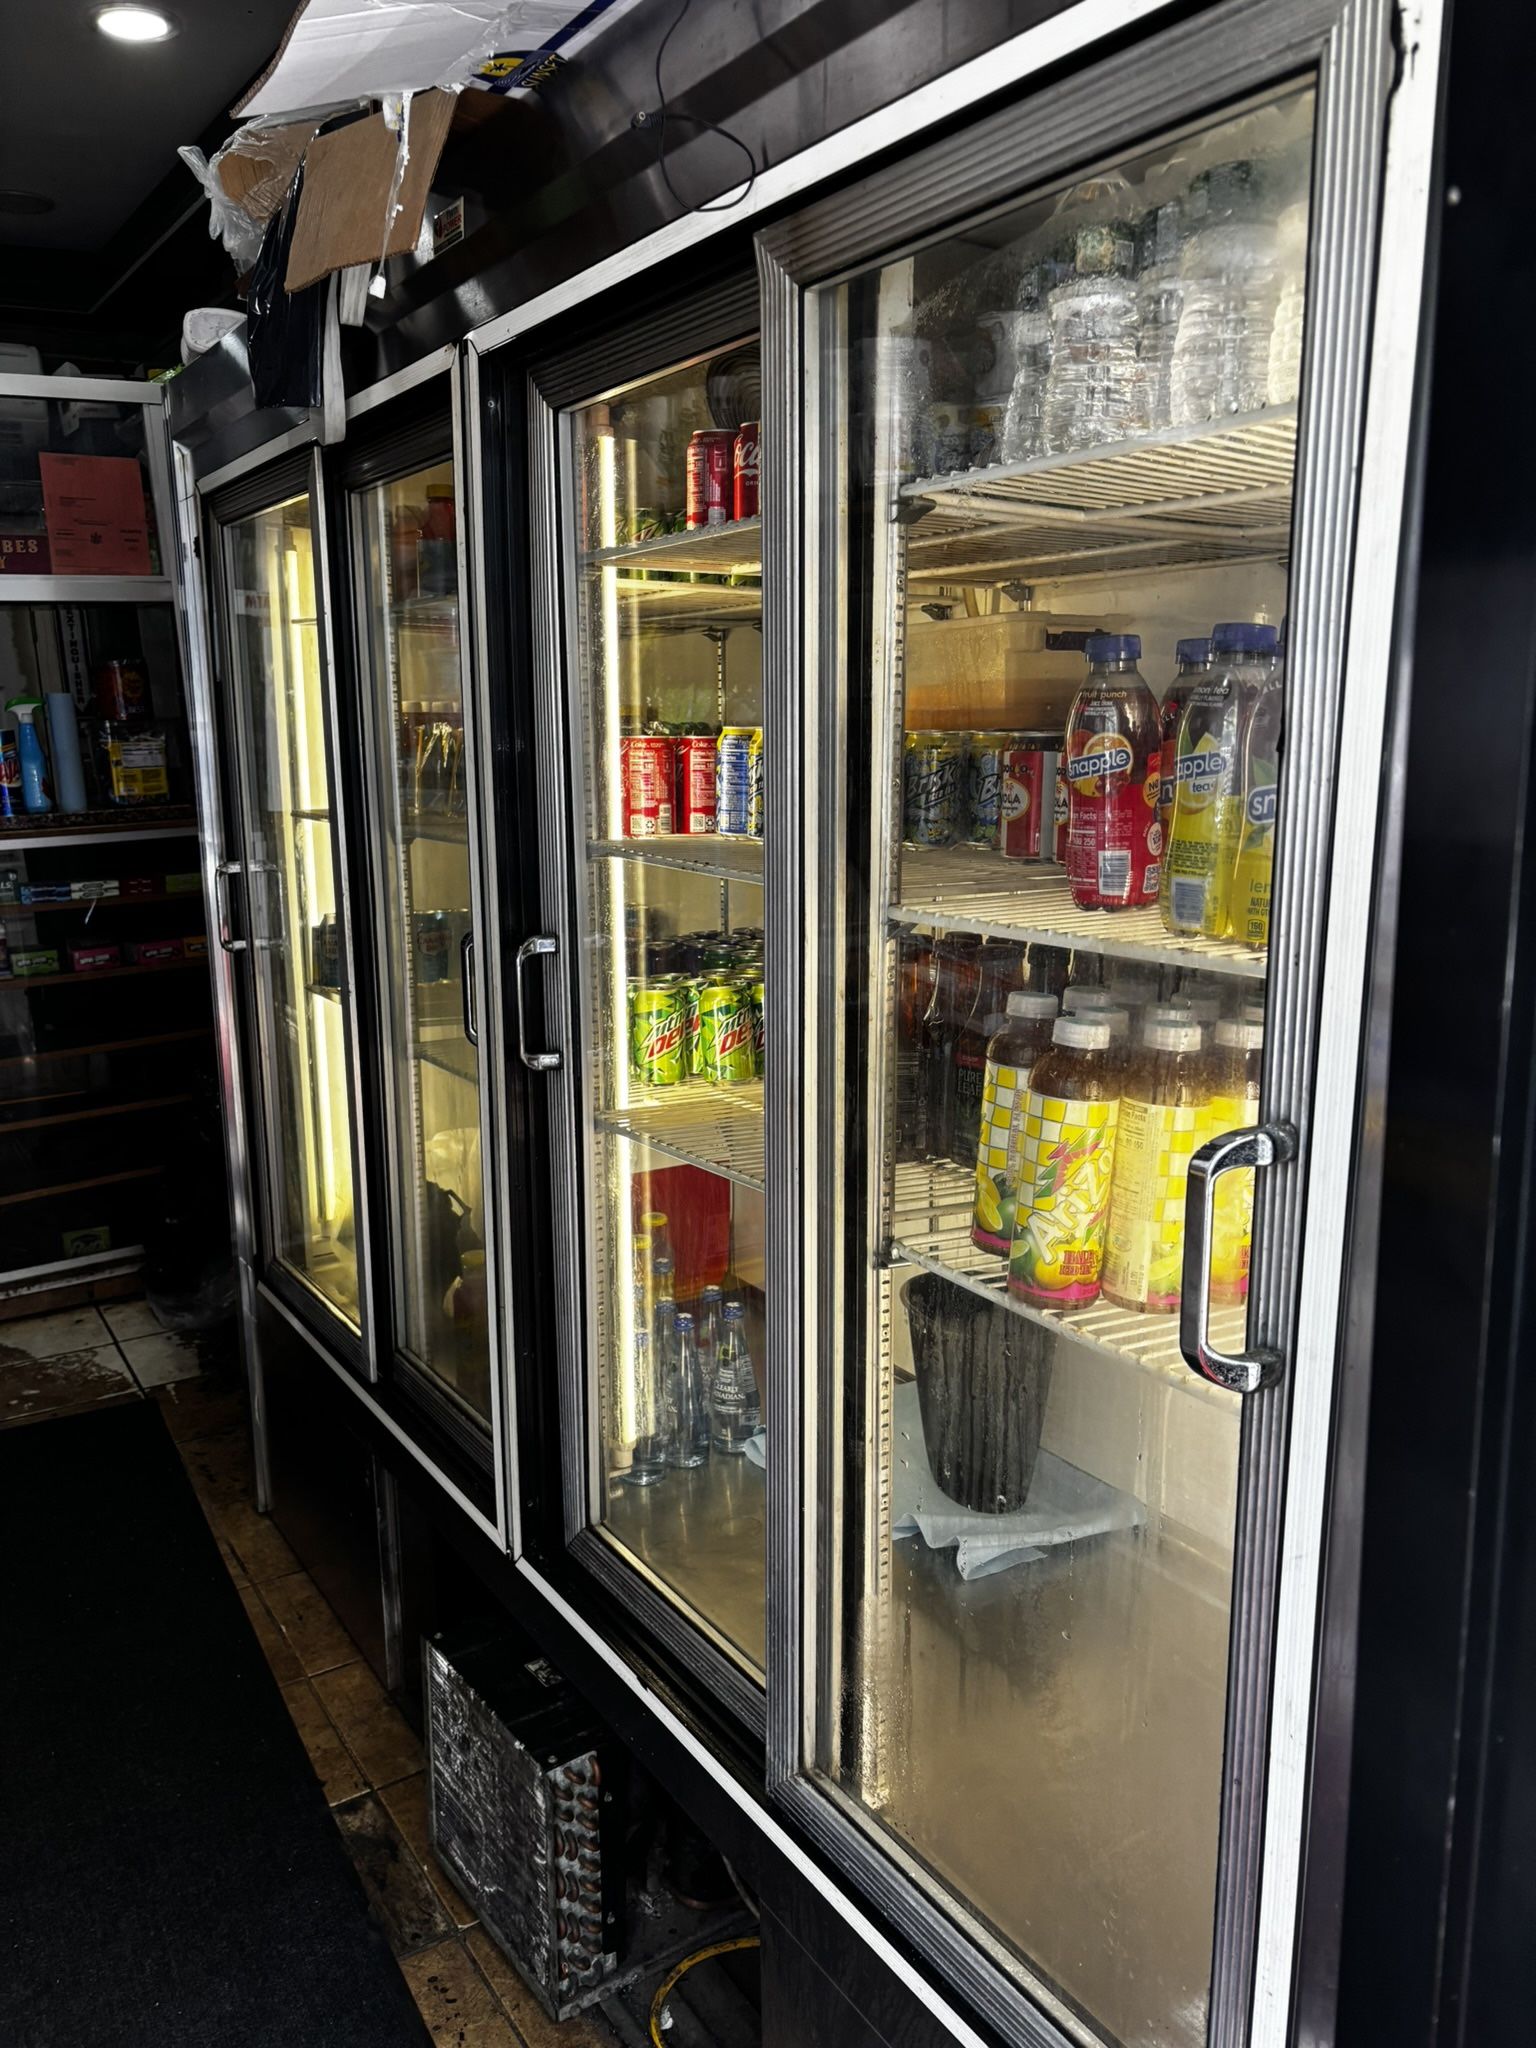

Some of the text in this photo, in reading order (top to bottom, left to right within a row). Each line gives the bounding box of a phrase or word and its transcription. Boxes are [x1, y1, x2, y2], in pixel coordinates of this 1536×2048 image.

[521, 53, 561, 87] SUNSET
[1100, 690, 1127, 700] punch
[691, 740, 709, 748] Coke
[1069, 750, 1128, 777] snapple
[1192, 783, 1210, 793] tea
